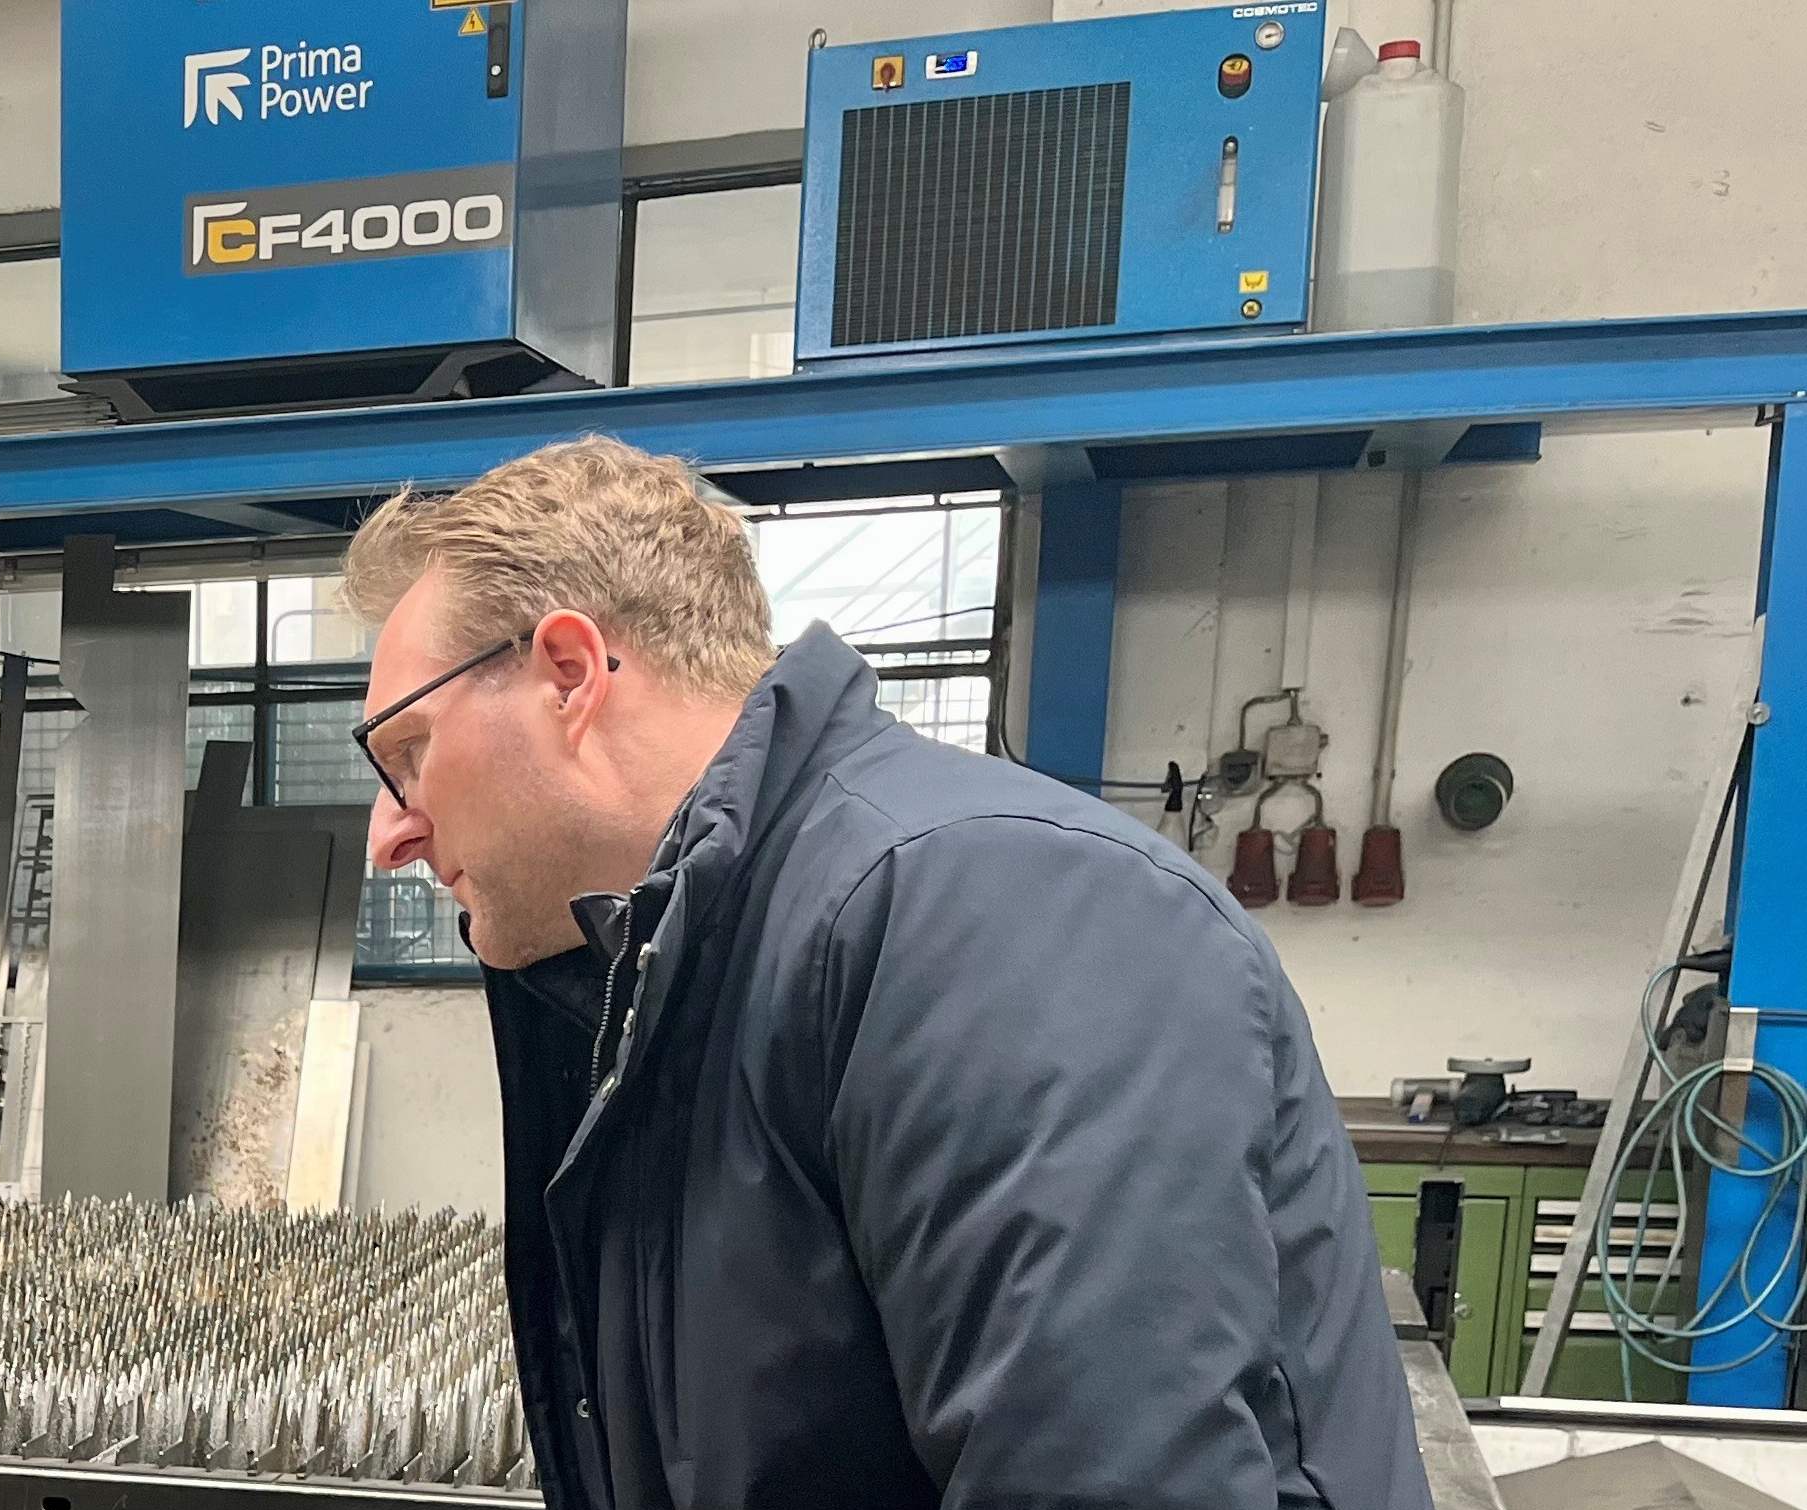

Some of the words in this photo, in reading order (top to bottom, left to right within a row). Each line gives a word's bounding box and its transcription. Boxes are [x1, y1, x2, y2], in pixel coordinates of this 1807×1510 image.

[1233, 2, 1318, 18] COSMOTEC
[261, 40, 362, 82] Prima
[260, 79, 374, 120] Power
[206, 194, 504, 263] CF4000
